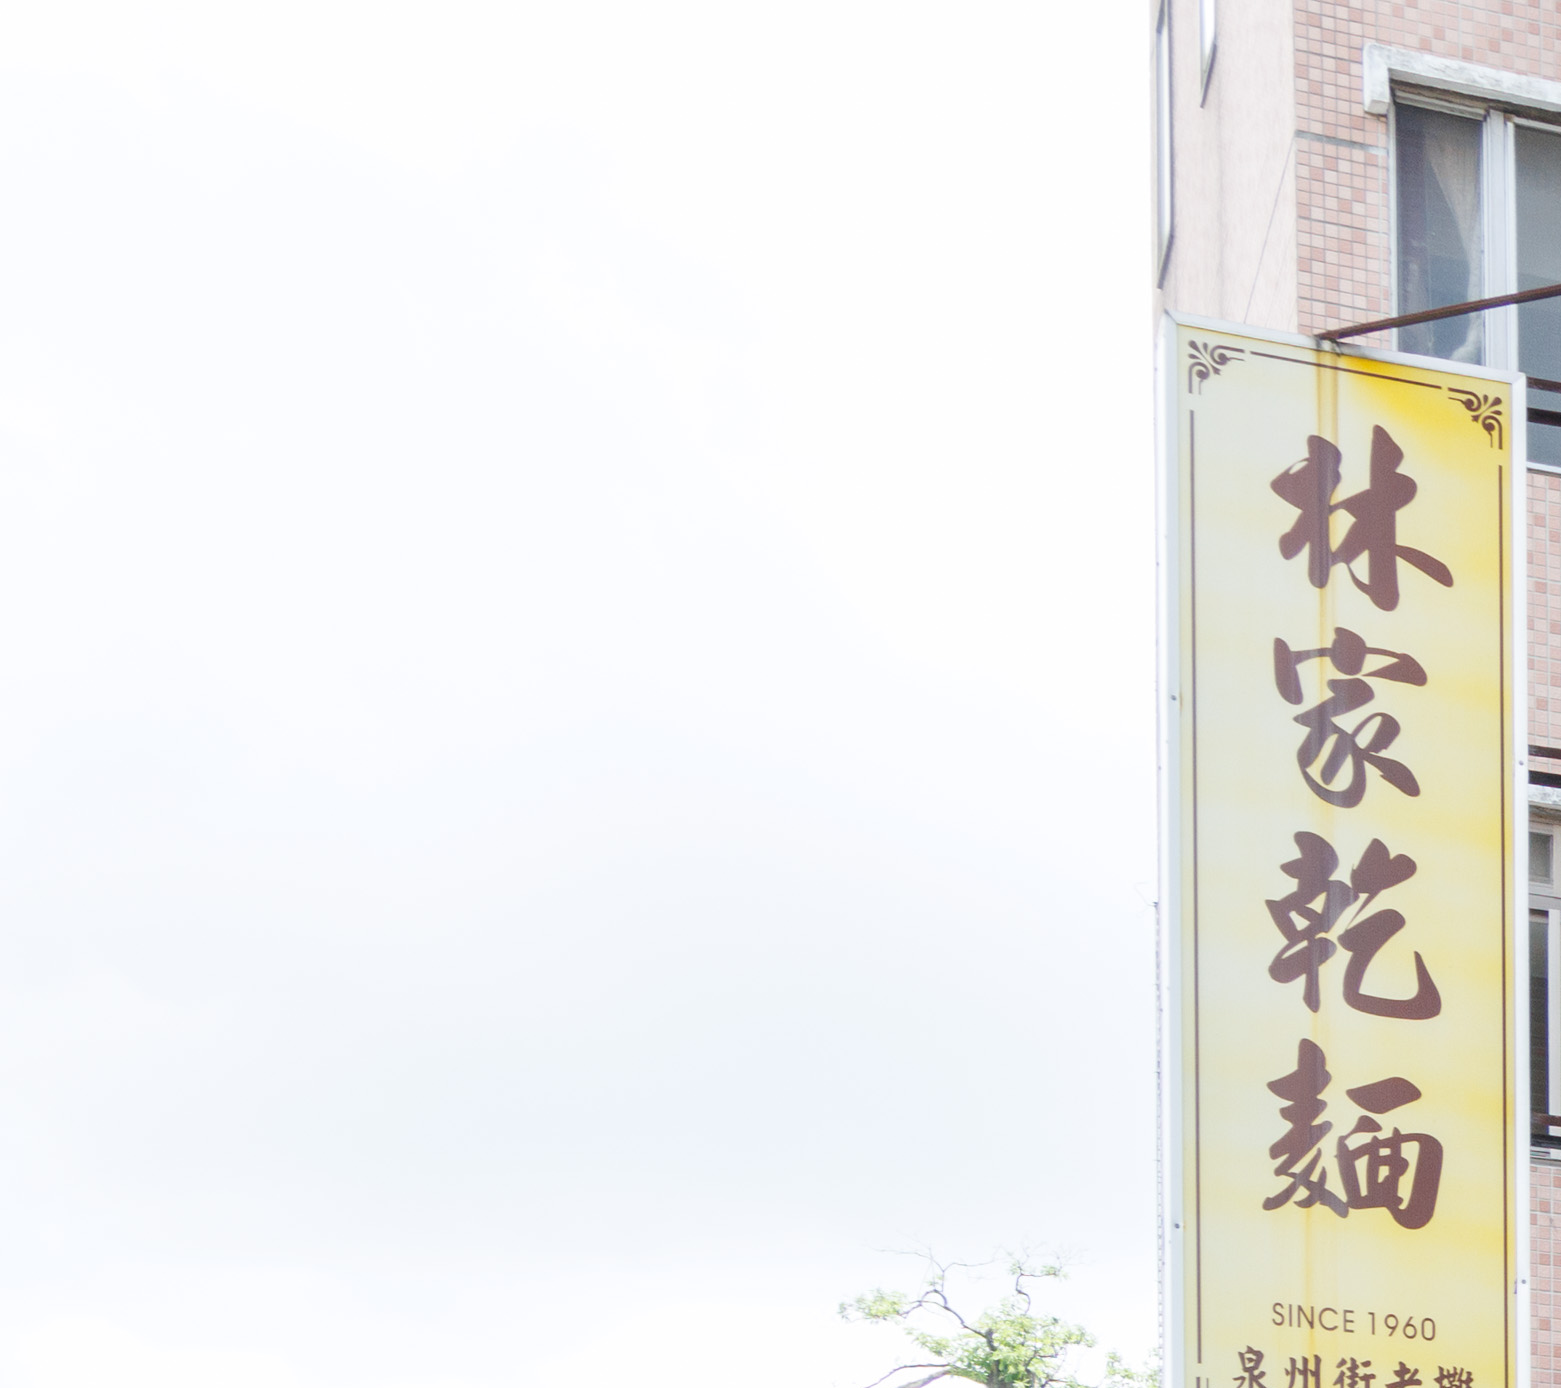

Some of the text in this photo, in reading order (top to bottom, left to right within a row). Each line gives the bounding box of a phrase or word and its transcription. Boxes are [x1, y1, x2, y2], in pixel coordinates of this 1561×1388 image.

[1262, 424, 1454, 1231] 林家乾麵
[1272, 1302, 1437, 1341] SINCE 1960
